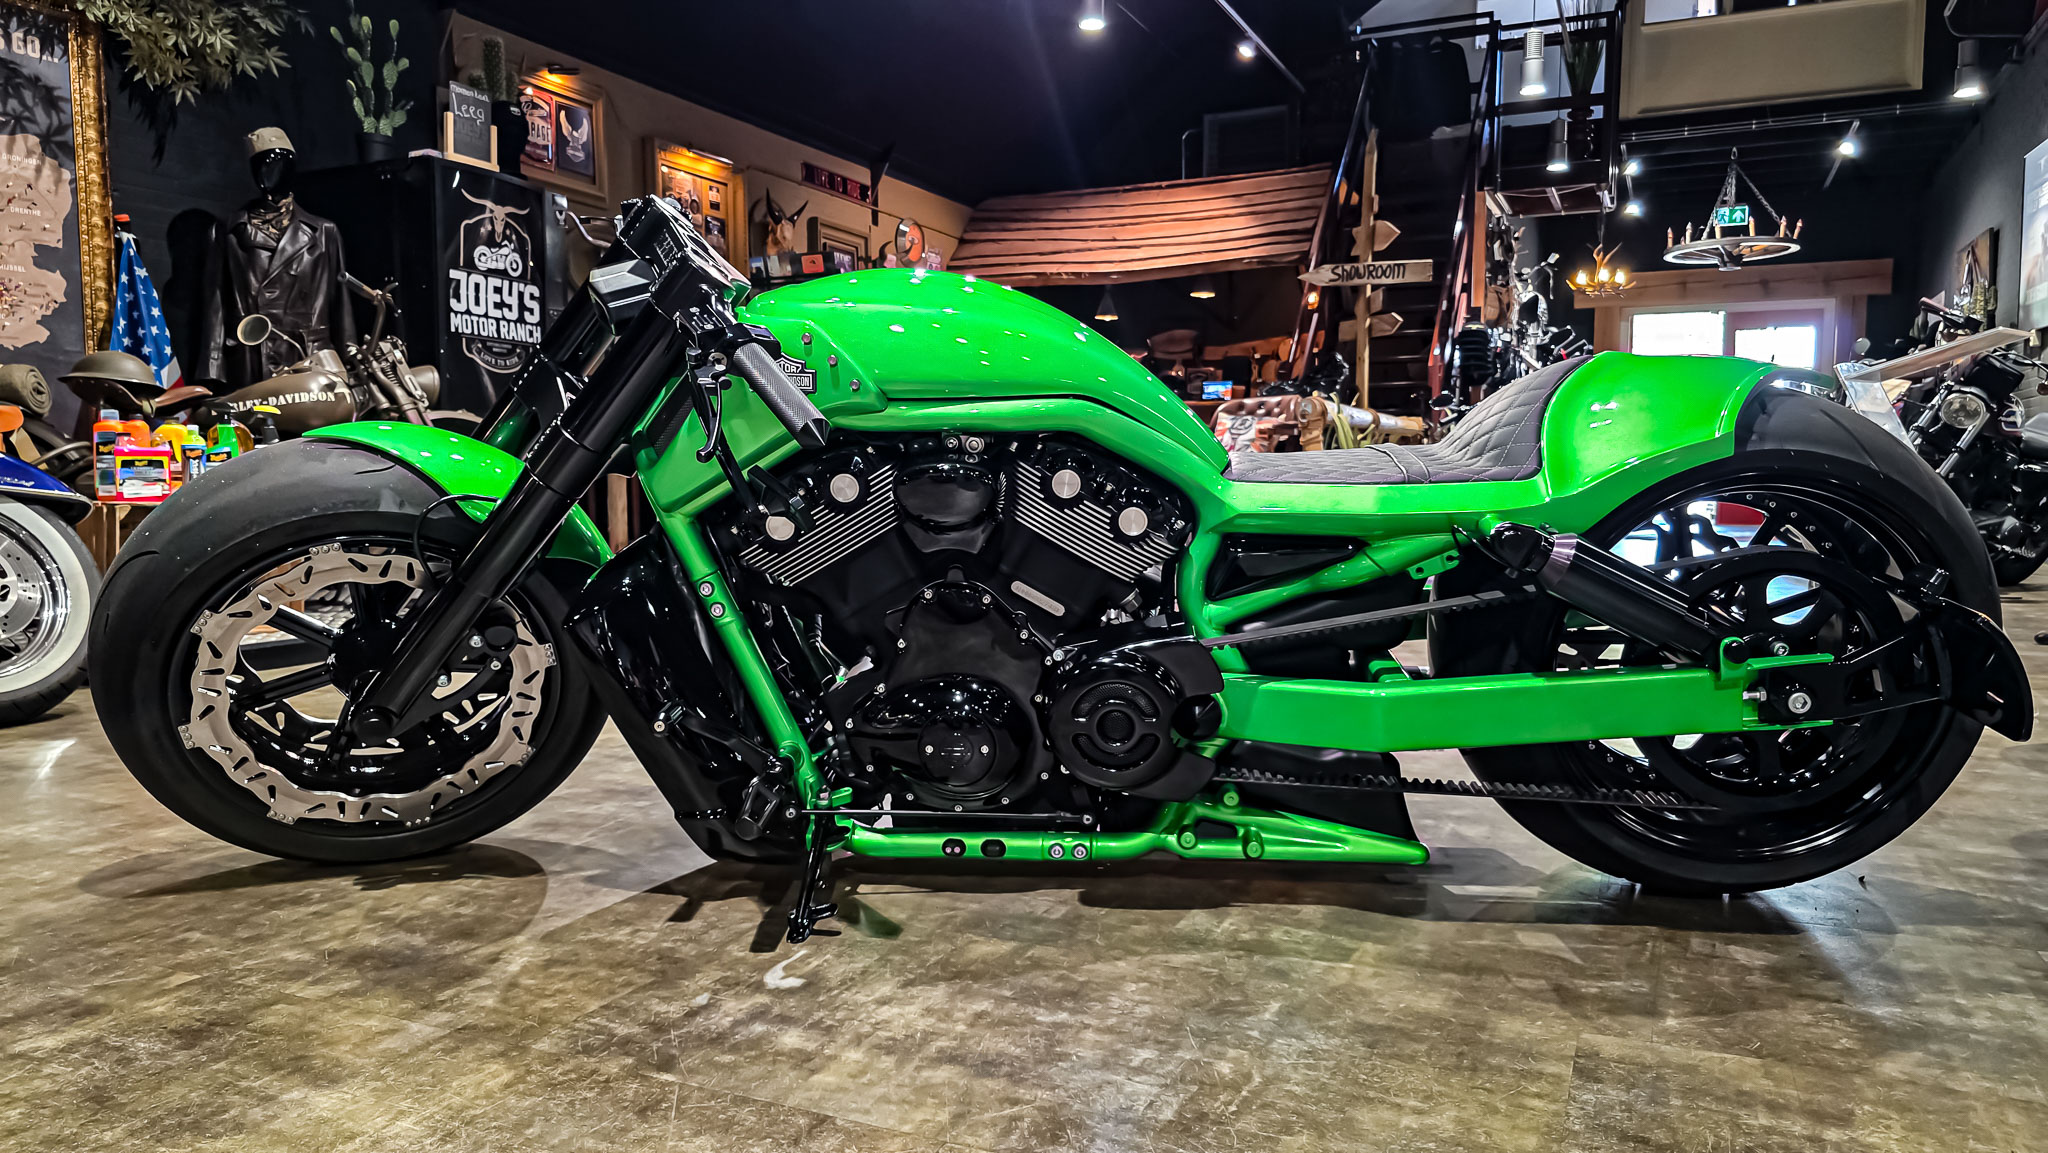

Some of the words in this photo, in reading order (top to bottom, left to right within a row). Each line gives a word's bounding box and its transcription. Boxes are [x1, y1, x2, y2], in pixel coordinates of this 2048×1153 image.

[531, 121, 551, 142] RAGE
[450, 312, 498, 338] MOTOR
[499, 319, 542, 344] RANCH
[230, 391, 336, 412] RLEY-DAVIDSON
